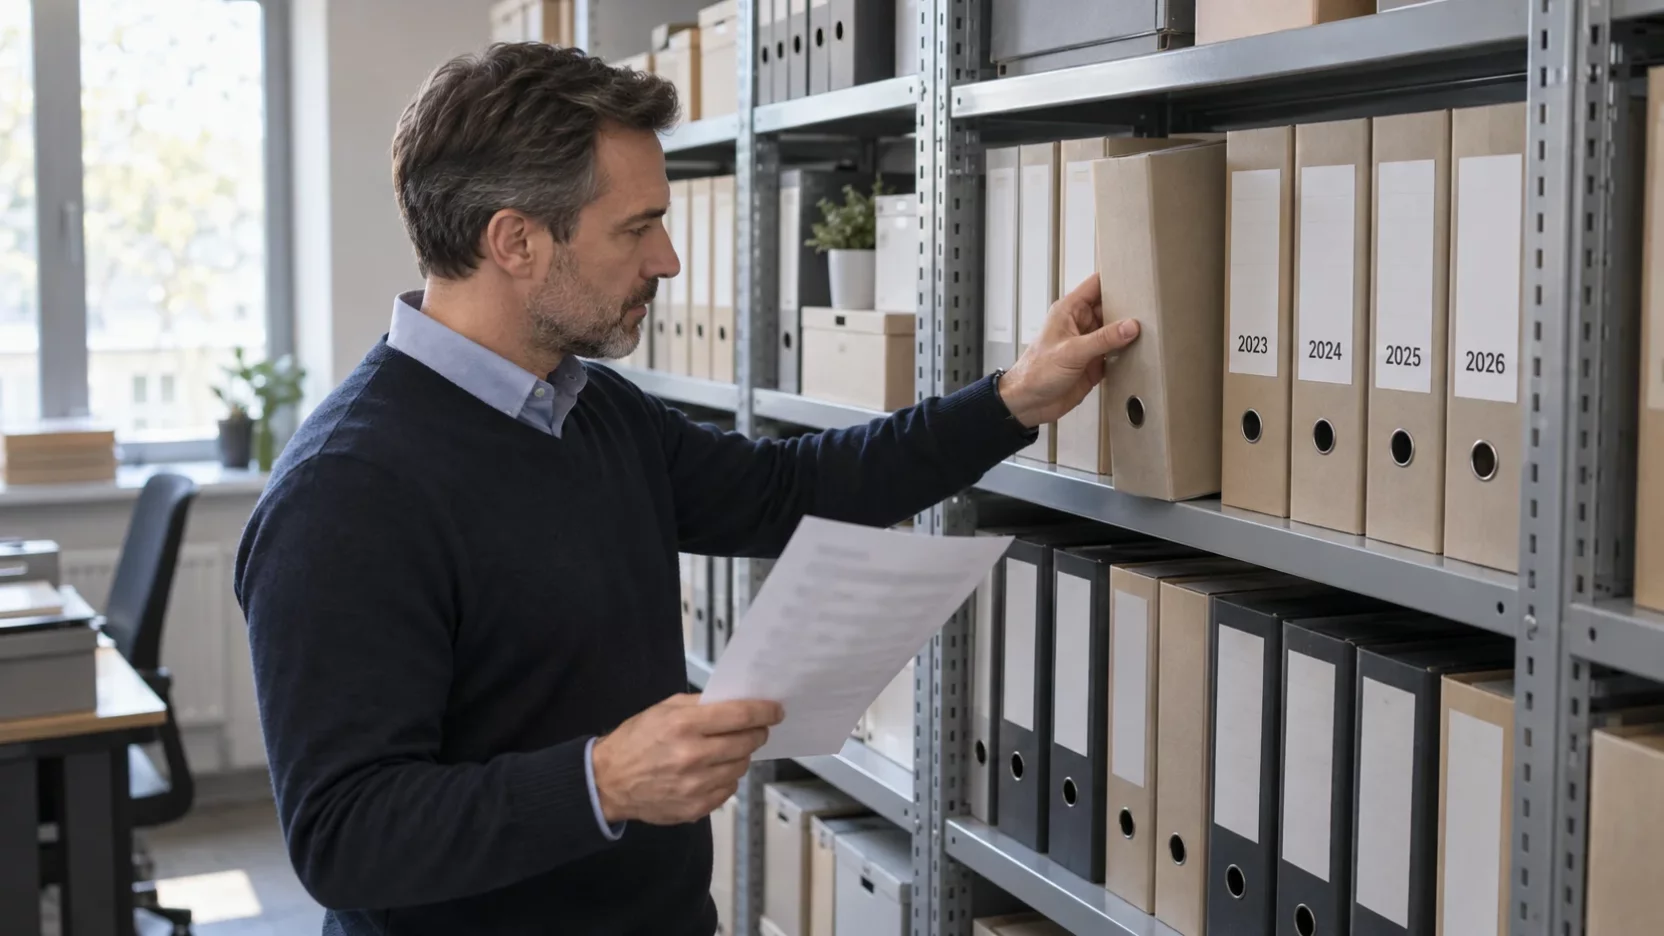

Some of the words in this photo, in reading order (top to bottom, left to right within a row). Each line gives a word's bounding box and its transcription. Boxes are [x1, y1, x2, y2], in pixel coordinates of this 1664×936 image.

[1237, 334, 1268, 354] 2023
[1308, 340, 1342, 360] 2024
[1385, 345, 1421, 367] 2025
[1465, 351, 1506, 374] 2026
